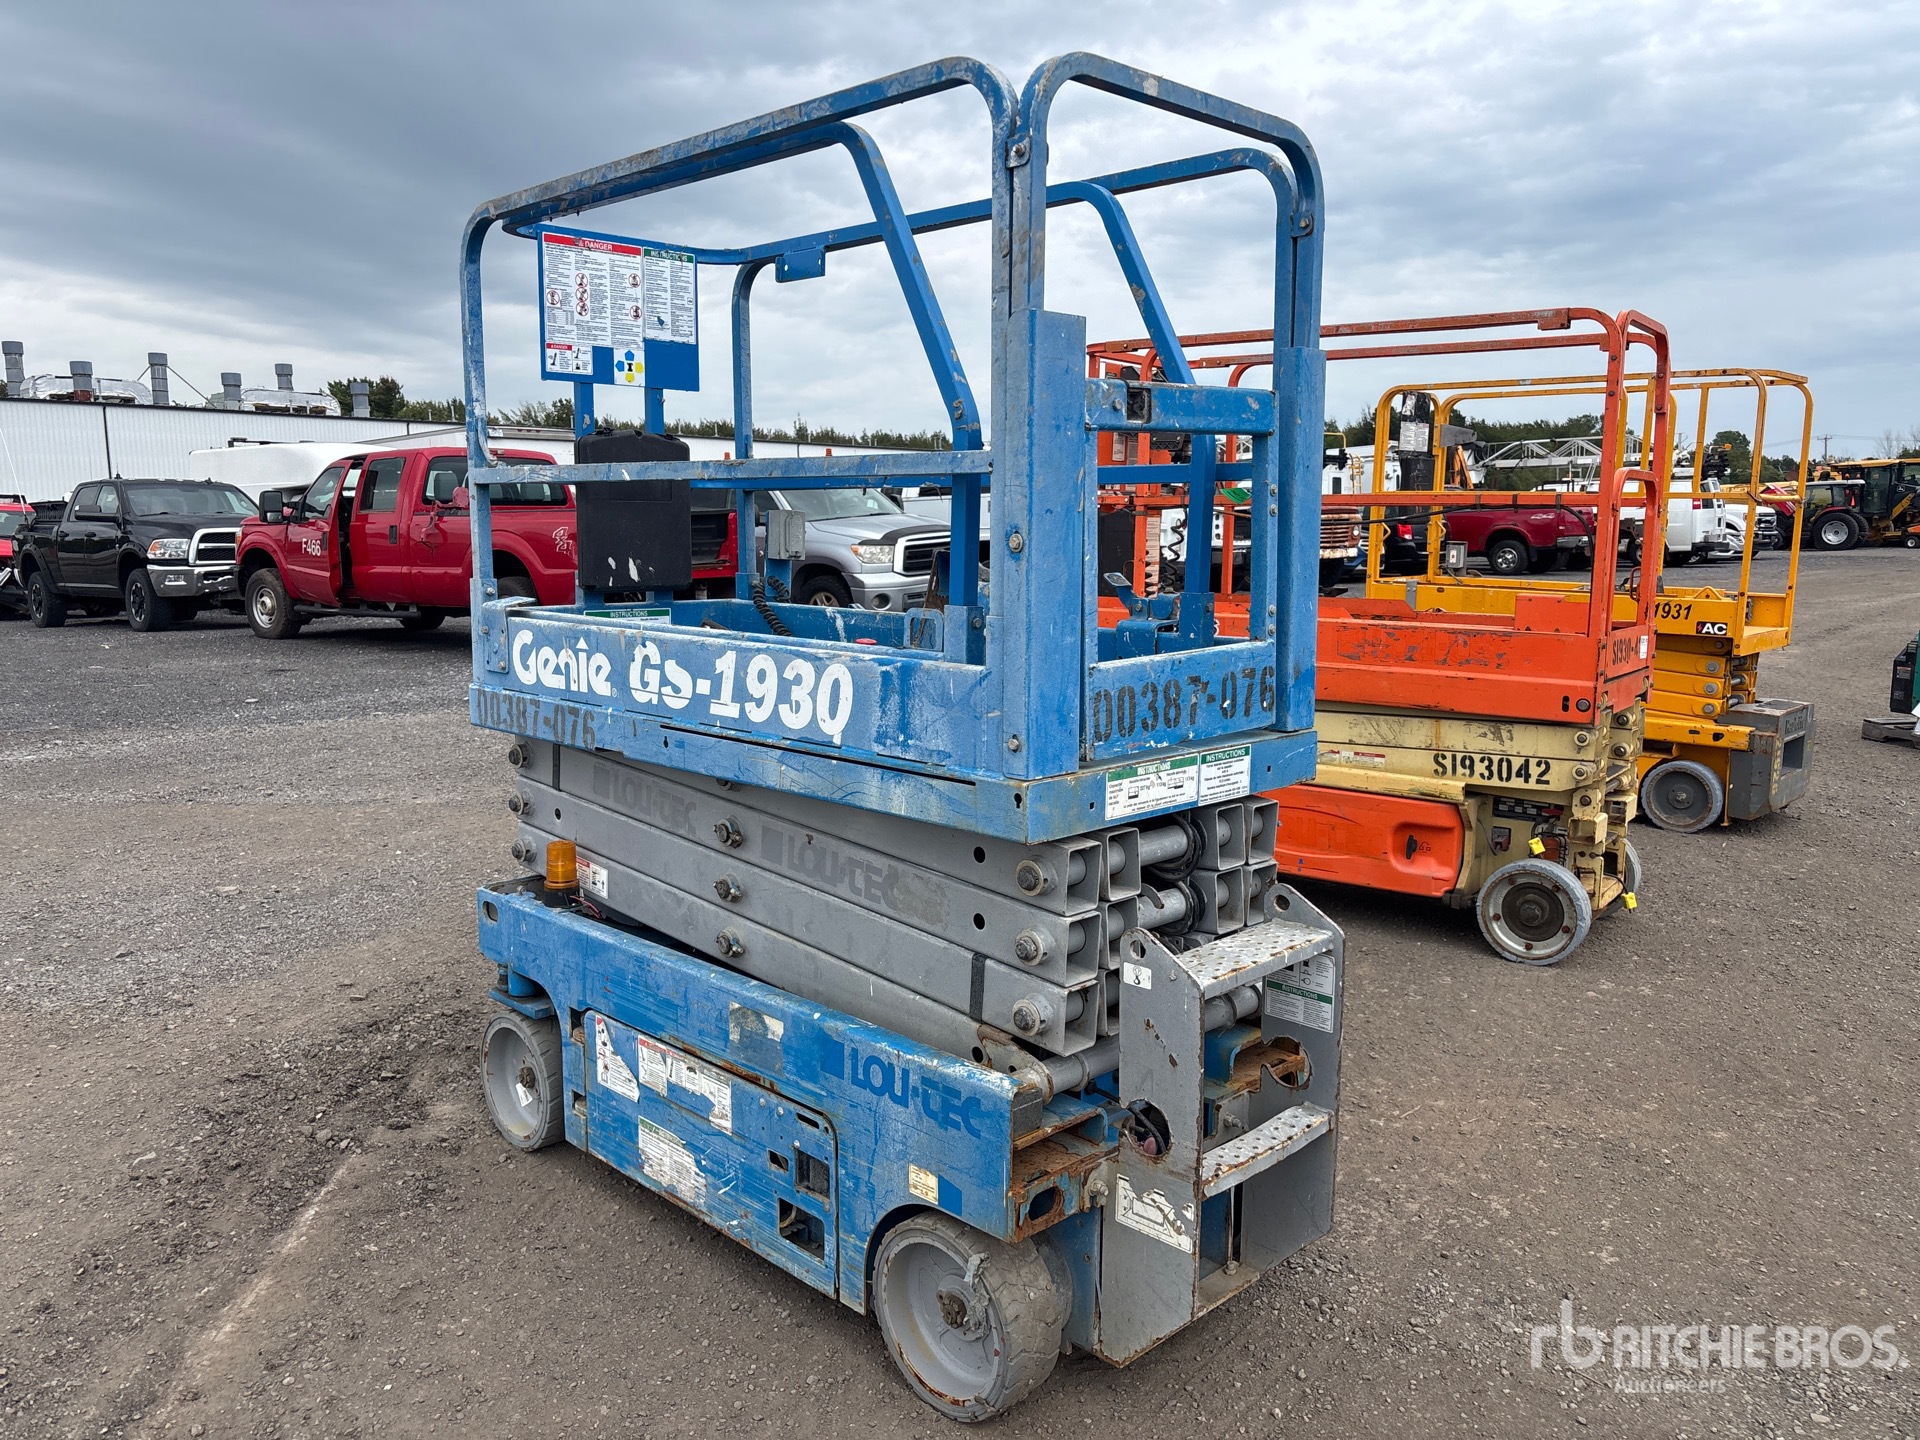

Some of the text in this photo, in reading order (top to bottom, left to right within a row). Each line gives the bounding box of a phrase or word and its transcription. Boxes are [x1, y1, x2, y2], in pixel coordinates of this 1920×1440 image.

[584, 240, 613, 251] DANGER
[650, 250, 688, 262] INSTRUCTIONS
[301, 537, 321, 556] F466
[1701, 622, 1727, 635] AC
[512, 628, 612, 698] Genie
[1093, 665, 1275, 742] 00387-076
[475, 690, 597, 750] 00387-076
[1206, 748, 1246, 763] INSTRUCTIONS
[1281, 984, 1318, 1000] INSTRUCTIONS
